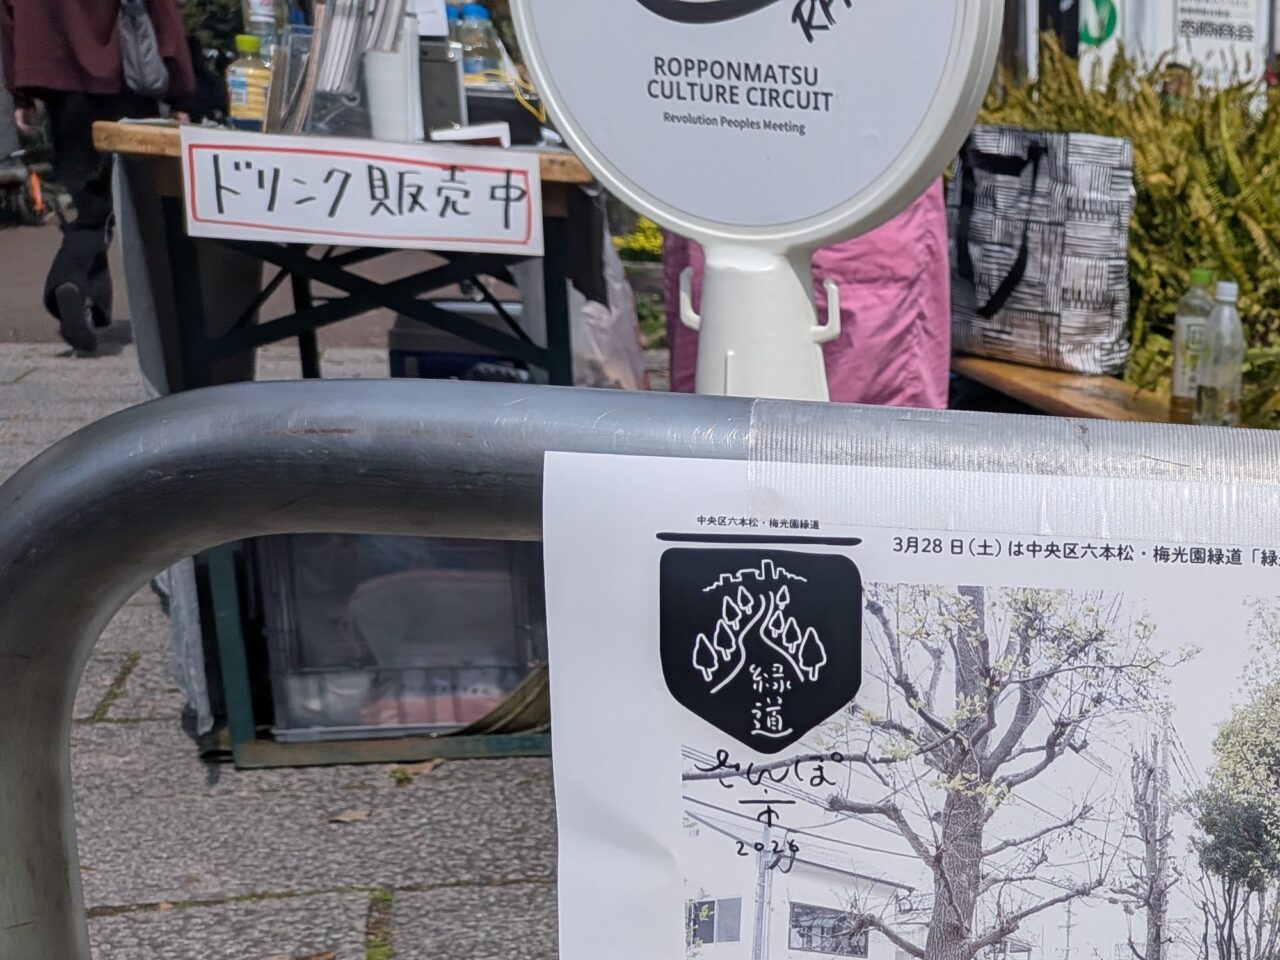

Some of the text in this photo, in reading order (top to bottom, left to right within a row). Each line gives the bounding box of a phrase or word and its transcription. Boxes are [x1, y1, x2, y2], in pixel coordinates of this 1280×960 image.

[654, 56, 818, 86] ROPPONMATSU
[647, 80, 833, 111] CULTURE CIRCUIT
[663, 112, 806, 136] Revolution Peoples Meeting
[212, 153, 529, 231] ドリンク販売中
[697, 515, 820, 530] 中央区六本松・梅光園緑道
